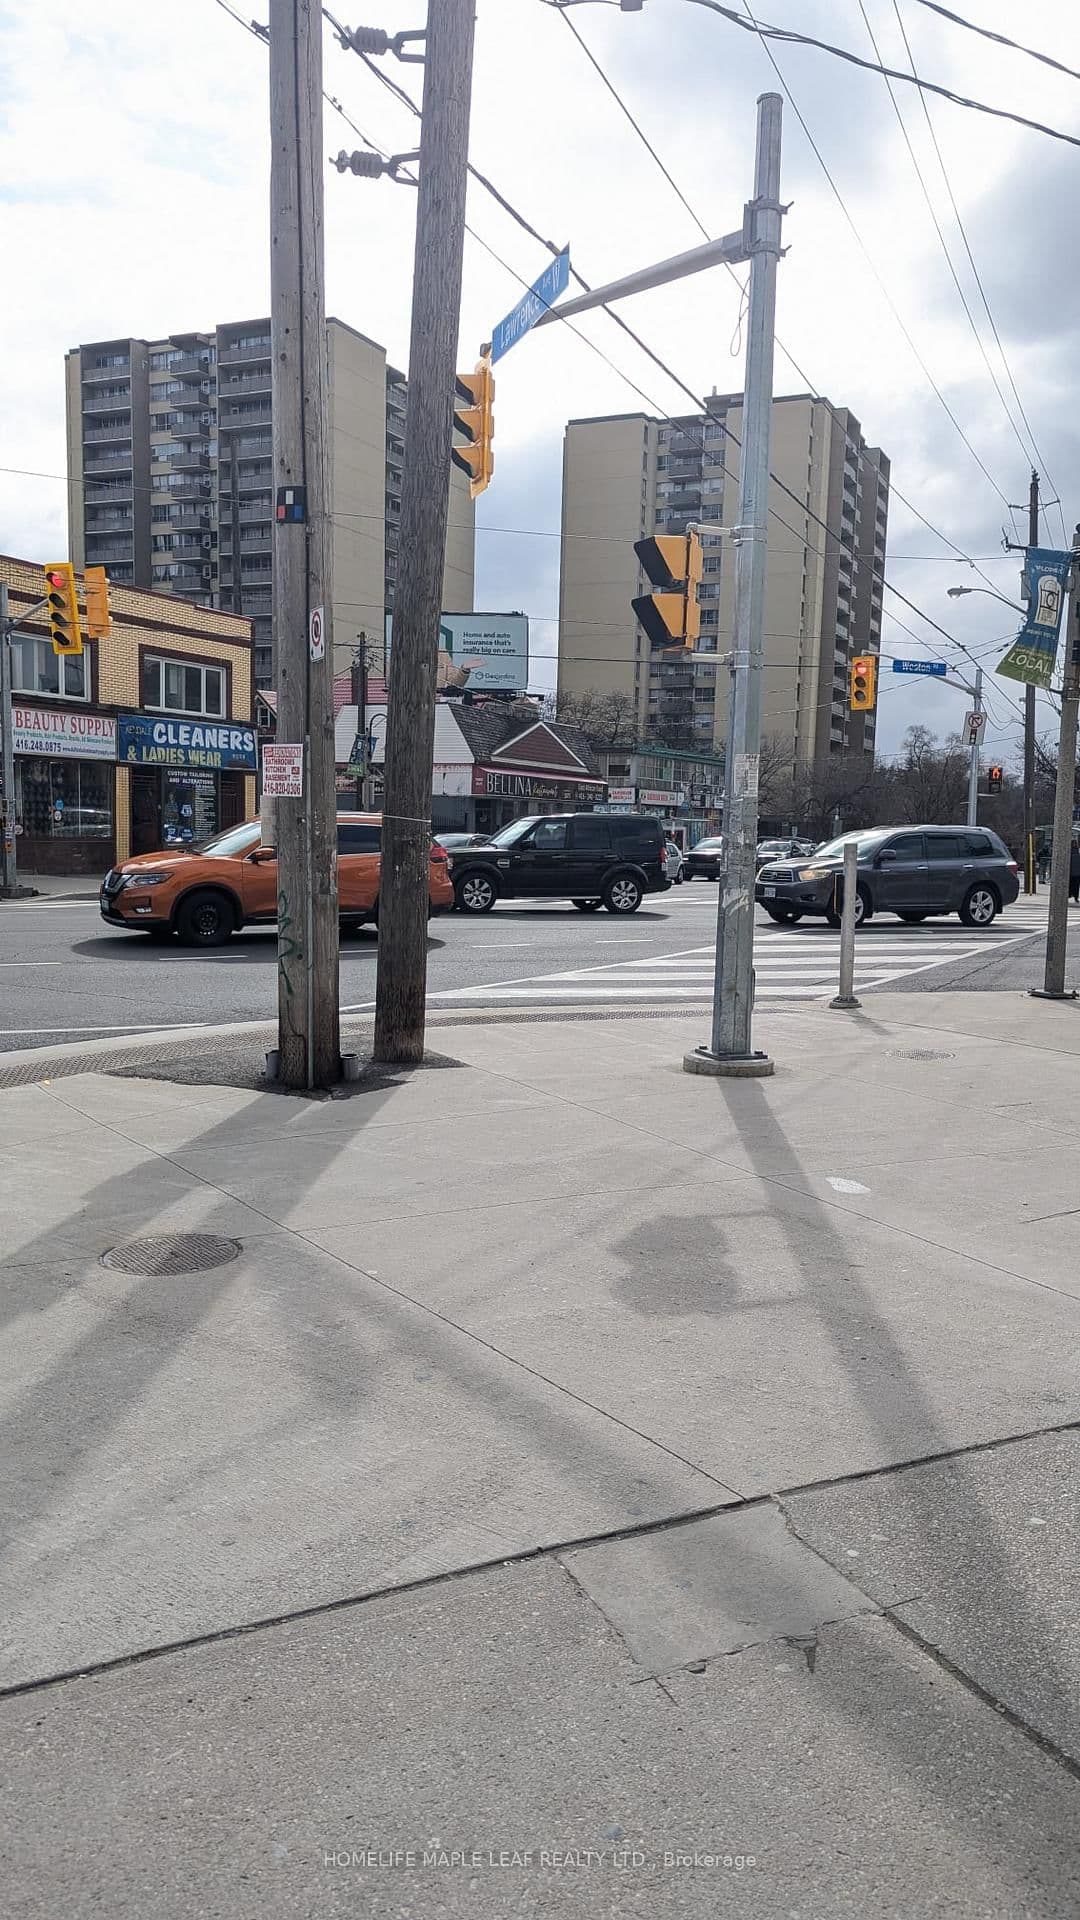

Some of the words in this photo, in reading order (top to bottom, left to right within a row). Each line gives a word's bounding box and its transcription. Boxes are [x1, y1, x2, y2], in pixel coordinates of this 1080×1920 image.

[499, 289, 541, 350] Lawrence
[552, 259, 561, 295] W
[1007, 651, 1051, 675] LOCAL
[15, 710, 67, 733] BEAUTY
[70, 716, 116, 738] SUPPLY
[15, 738, 62, 753] 416.248.0875
[153, 722, 254, 752] CLEANERS
[127, 744, 138, 761] &
[142, 745, 185, 763] LADIES
[188, 748, 222, 767] WEAR
[487, 772, 532, 796] BELLINA
